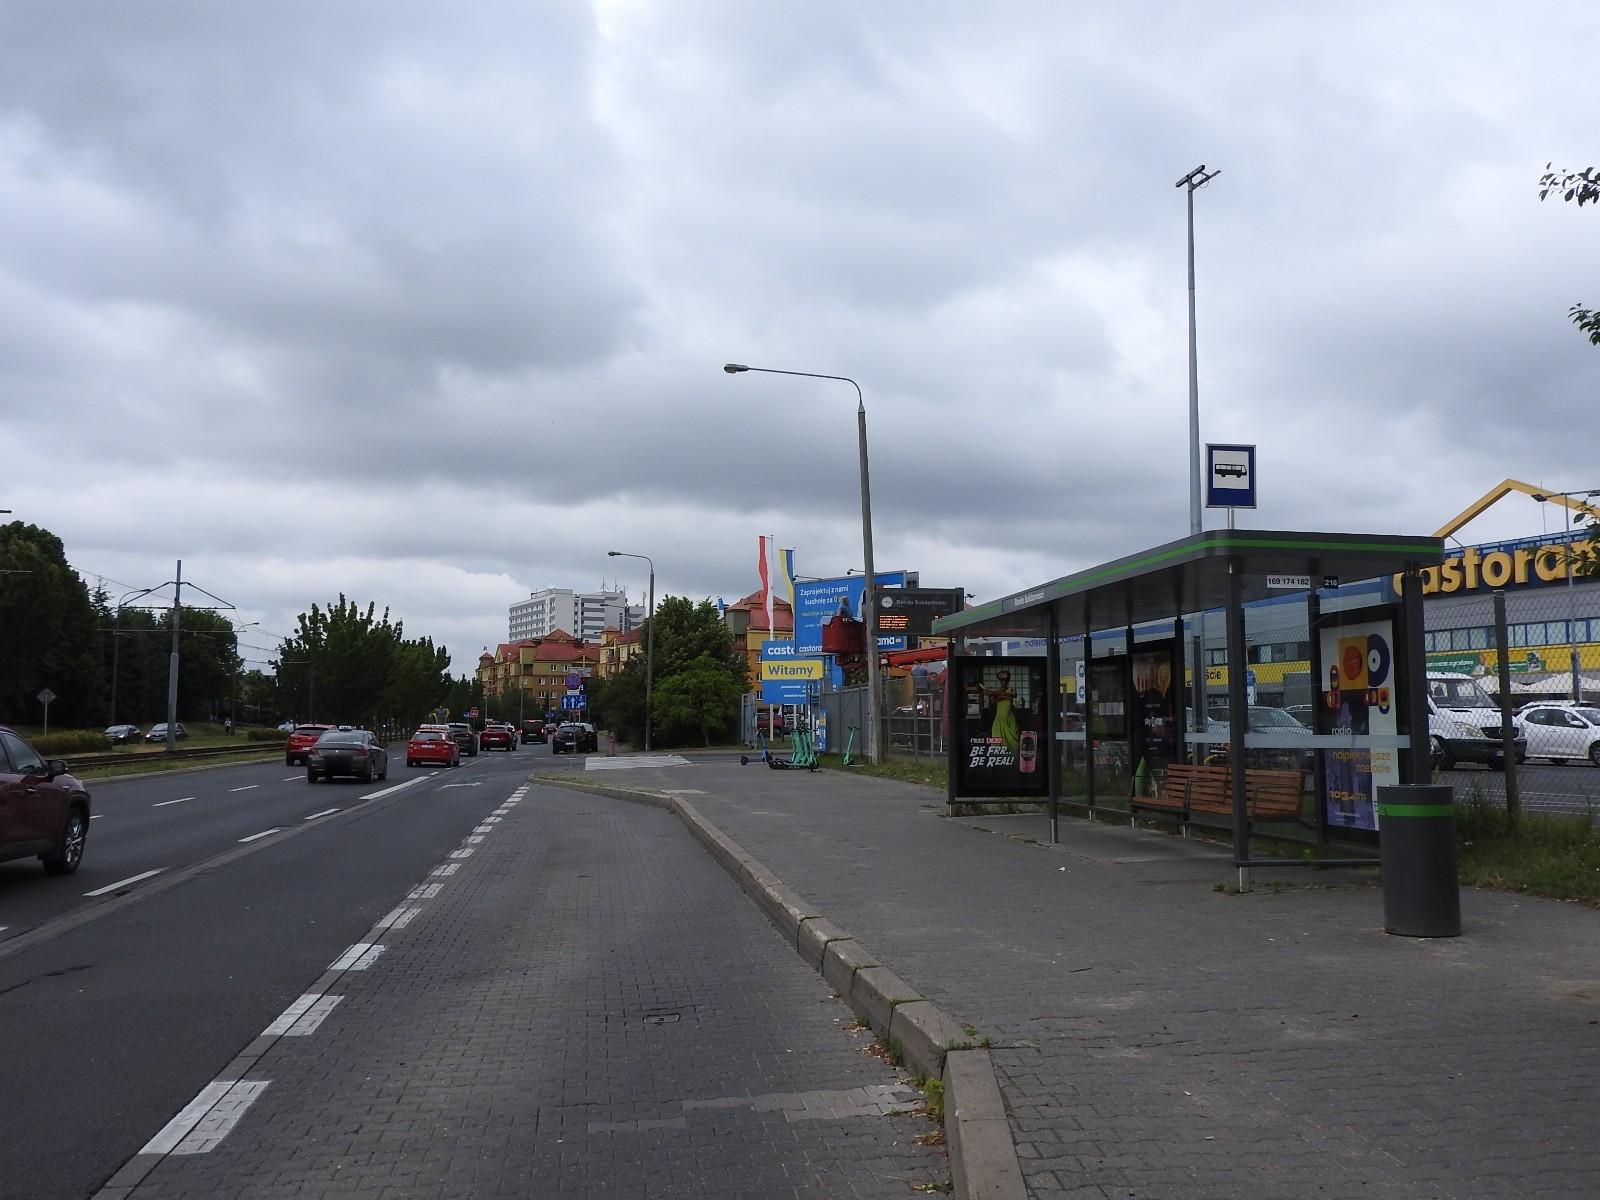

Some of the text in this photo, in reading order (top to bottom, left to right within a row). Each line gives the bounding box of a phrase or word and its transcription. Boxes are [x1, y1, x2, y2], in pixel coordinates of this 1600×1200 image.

[768, 664, 814, 678] Witamy
[969, 746, 986, 757] BE
[969, 756, 1015, 768] BE REAL!
